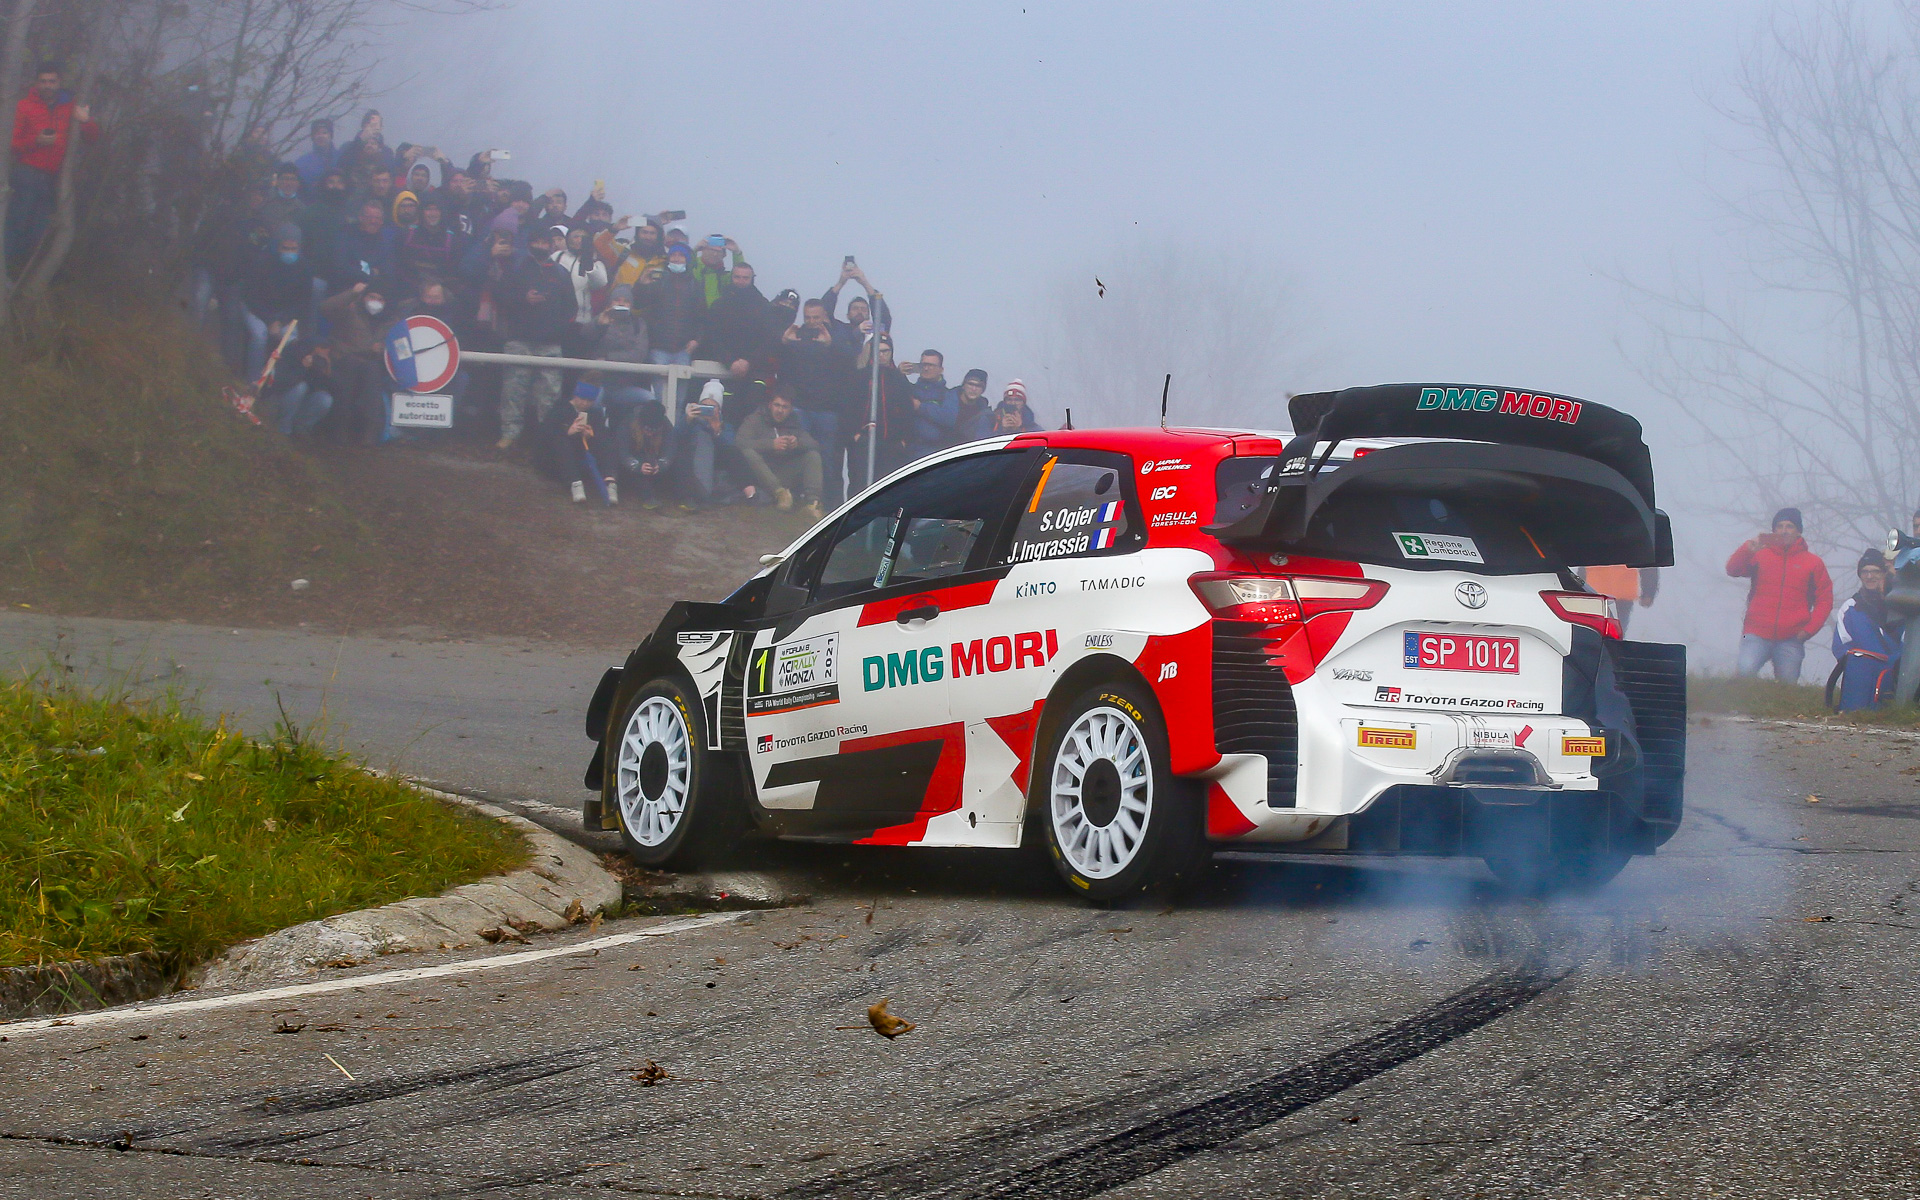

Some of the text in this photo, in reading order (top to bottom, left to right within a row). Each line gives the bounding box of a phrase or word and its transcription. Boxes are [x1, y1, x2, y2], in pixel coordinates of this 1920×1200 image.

[405, 400, 440, 409] eccetto
[1416, 388, 1582, 425] DMG MORI
[398, 411, 447, 421] autorizzati
[1154, 464, 1192, 472] AIRLINES
[1155, 458, 1182, 466] JAPAN
[1028, 456, 1058, 513] 1
[1040, 507, 1098, 533] S.Ogier
[1152, 511, 1198, 522] NISULA
[1007, 532, 1090, 563] J.Ingrassia
[1424, 538, 1463, 549] Regione
[1427, 546, 1477, 557] Lombardia
[1080, 576, 1146, 591] TAMADIC
[1084, 634, 1114, 647] ENDLESS
[824, 638, 834, 678] 2021
[862, 628, 1059, 693] DMG MORI
[1404, 637, 1516, 669] EST SP 1012
[756, 649, 768, 692] 1
[784, 670, 815, 687] MONZA
[1157, 661, 1178, 683] JTB
[1332, 668, 1375, 682] YARIS
[1375, 691, 1544, 712] GR TOYOTA GAZOO Racing
[775, 735, 806, 749] TOYOTA
[807, 729, 836, 743] GAZOO
[837, 723, 868, 736] Racing
[1361, 730, 1414, 747] PIRELLI
[1473, 731, 1509, 739] NISULA
[1565, 739, 1604, 754] PIRELLI
